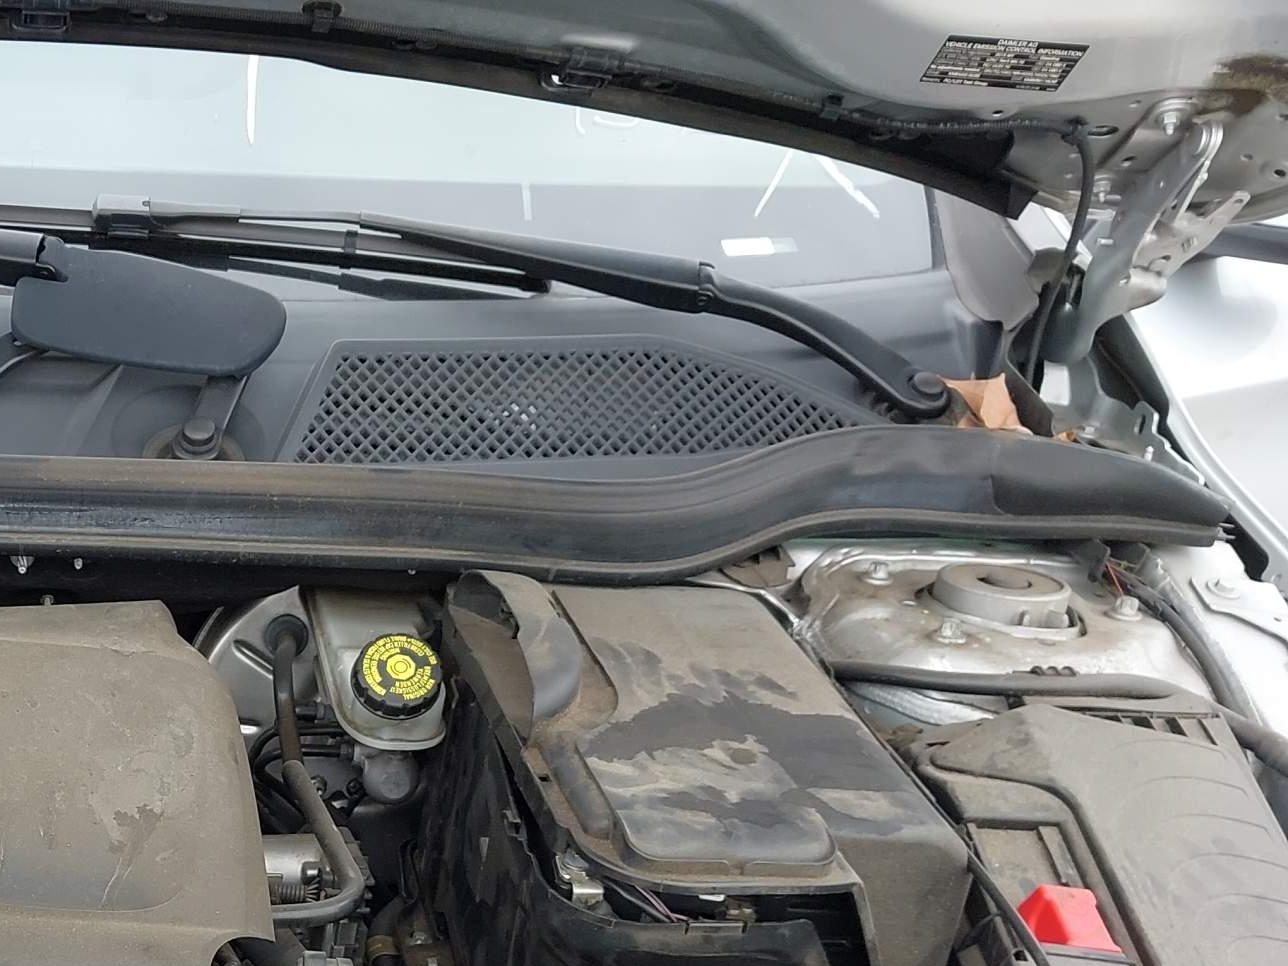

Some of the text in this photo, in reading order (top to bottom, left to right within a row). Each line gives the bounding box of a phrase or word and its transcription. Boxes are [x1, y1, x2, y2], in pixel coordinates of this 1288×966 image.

[945, 41, 1084, 57] VEHICLE EMISSION CONTROL INFORMATION
[997, 39, 1027, 47] DAIMLER
